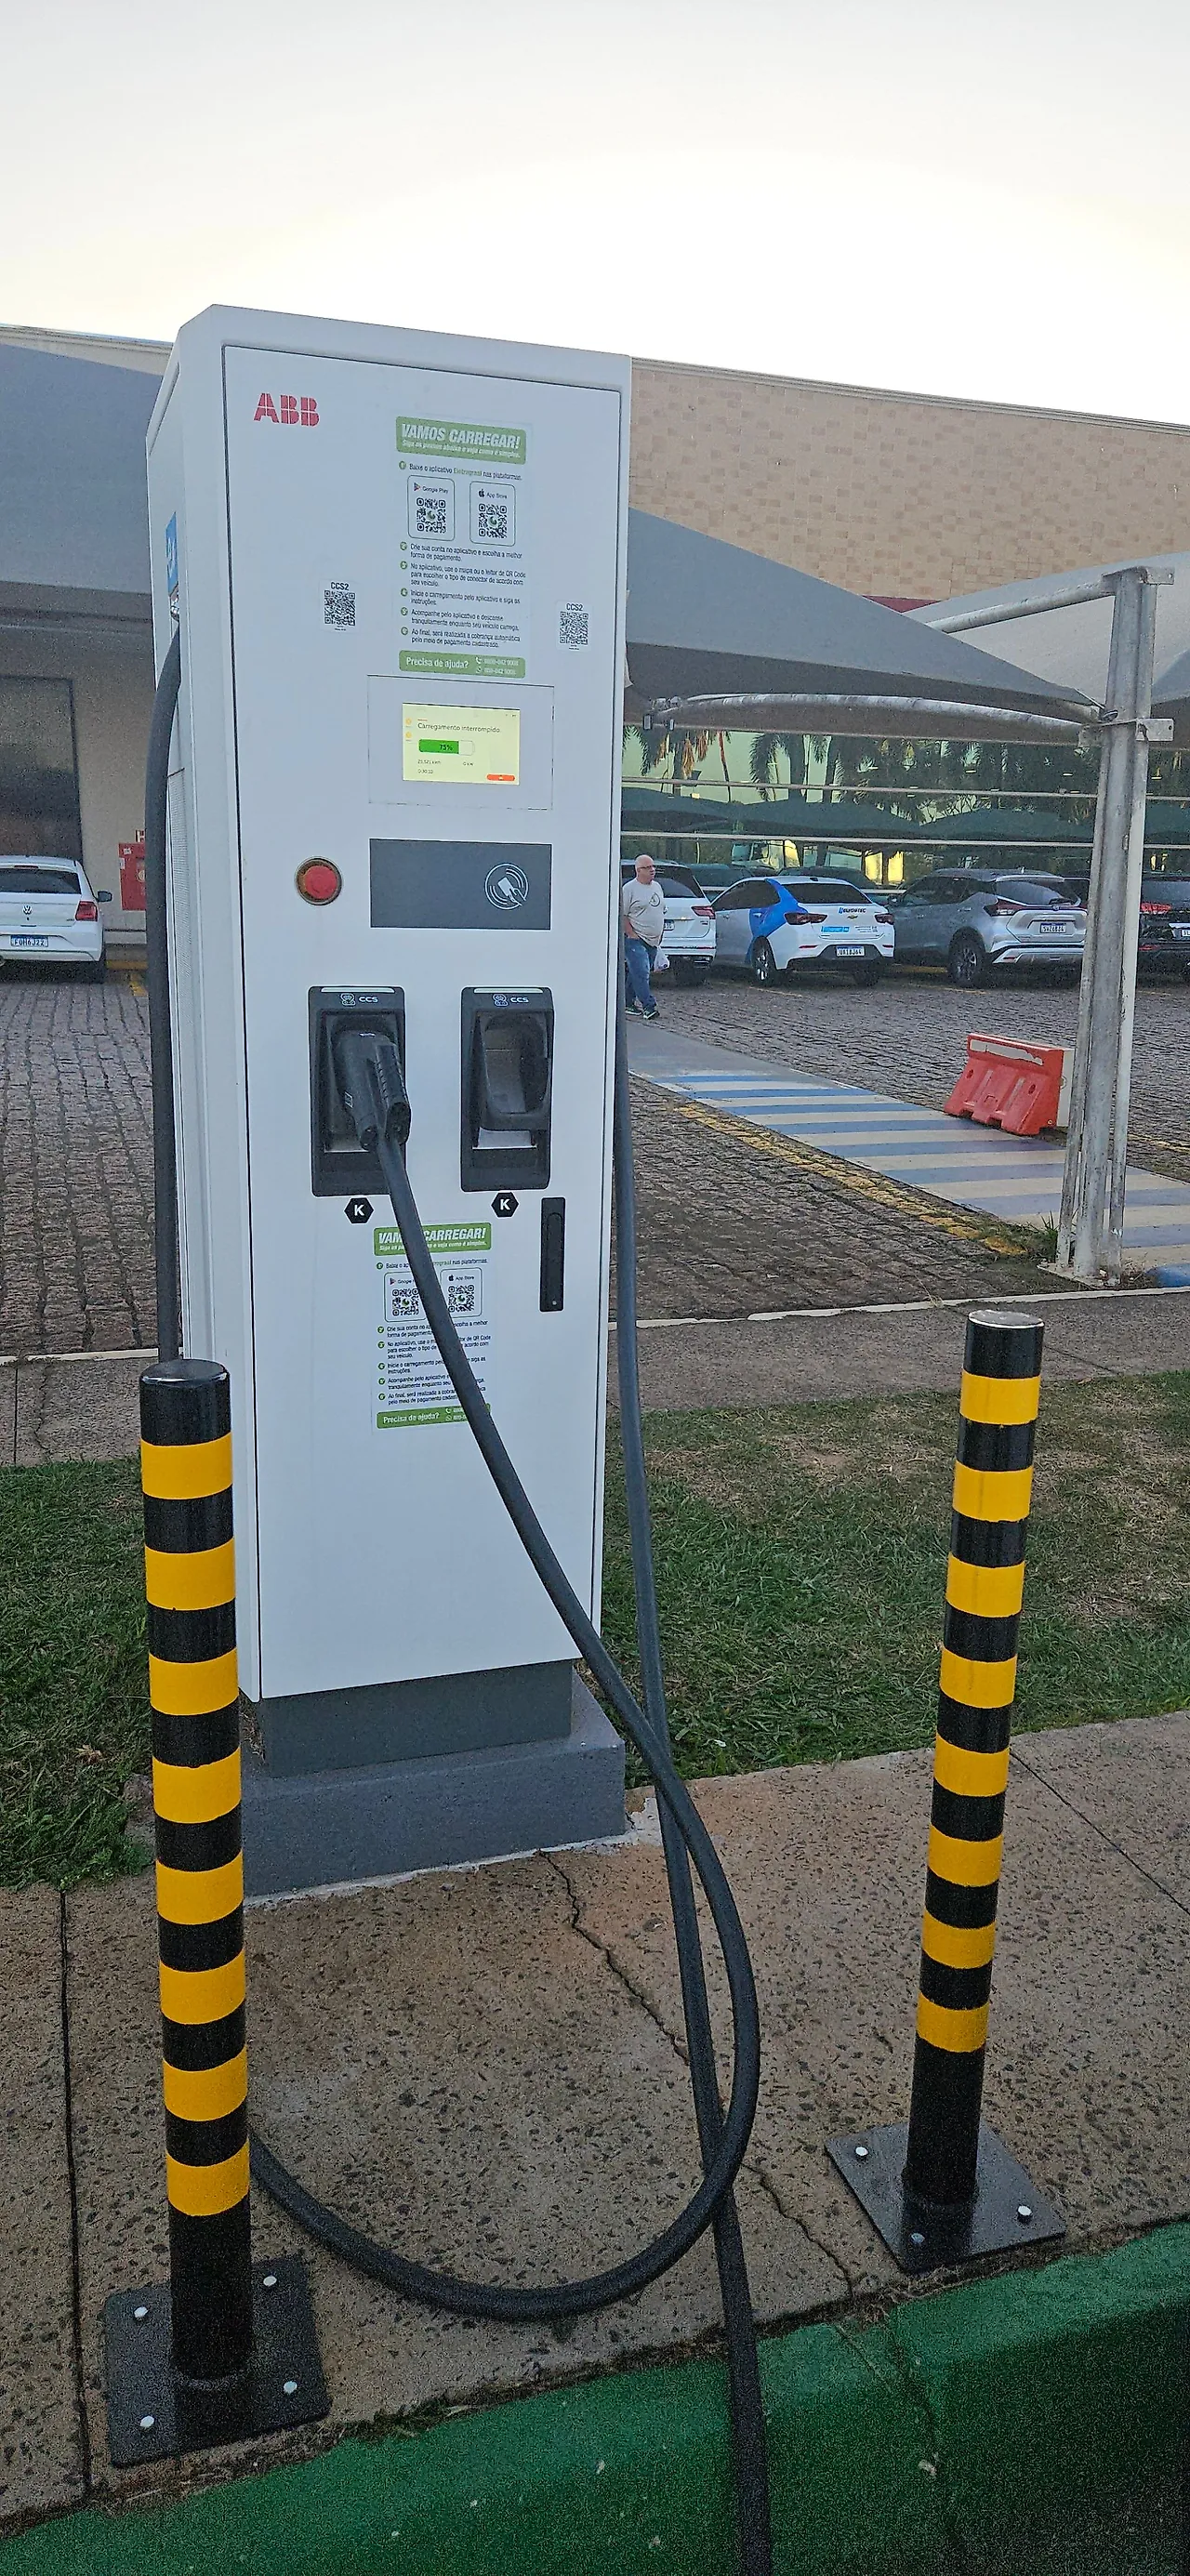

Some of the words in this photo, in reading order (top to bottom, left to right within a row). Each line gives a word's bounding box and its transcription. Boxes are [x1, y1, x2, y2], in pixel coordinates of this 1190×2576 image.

[254, 392, 320, 427] ABB
[402, 424, 445, 441] VAMOS
[449, 429, 521, 448] CARREGAR!
[331, 582, 349, 590] CCS2
[406, 656, 432, 667] Precisa
[434, 658, 443, 667] de
[444, 659, 469, 669] ajuda?
[417, 722, 460, 731] Carregamento
[354, 1205, 364, 1215] K
[500, 1199, 510, 1210] K
[424, 1228, 486, 1241] CARREGAR!
[417, 1412, 439, 1421] ajuda?
